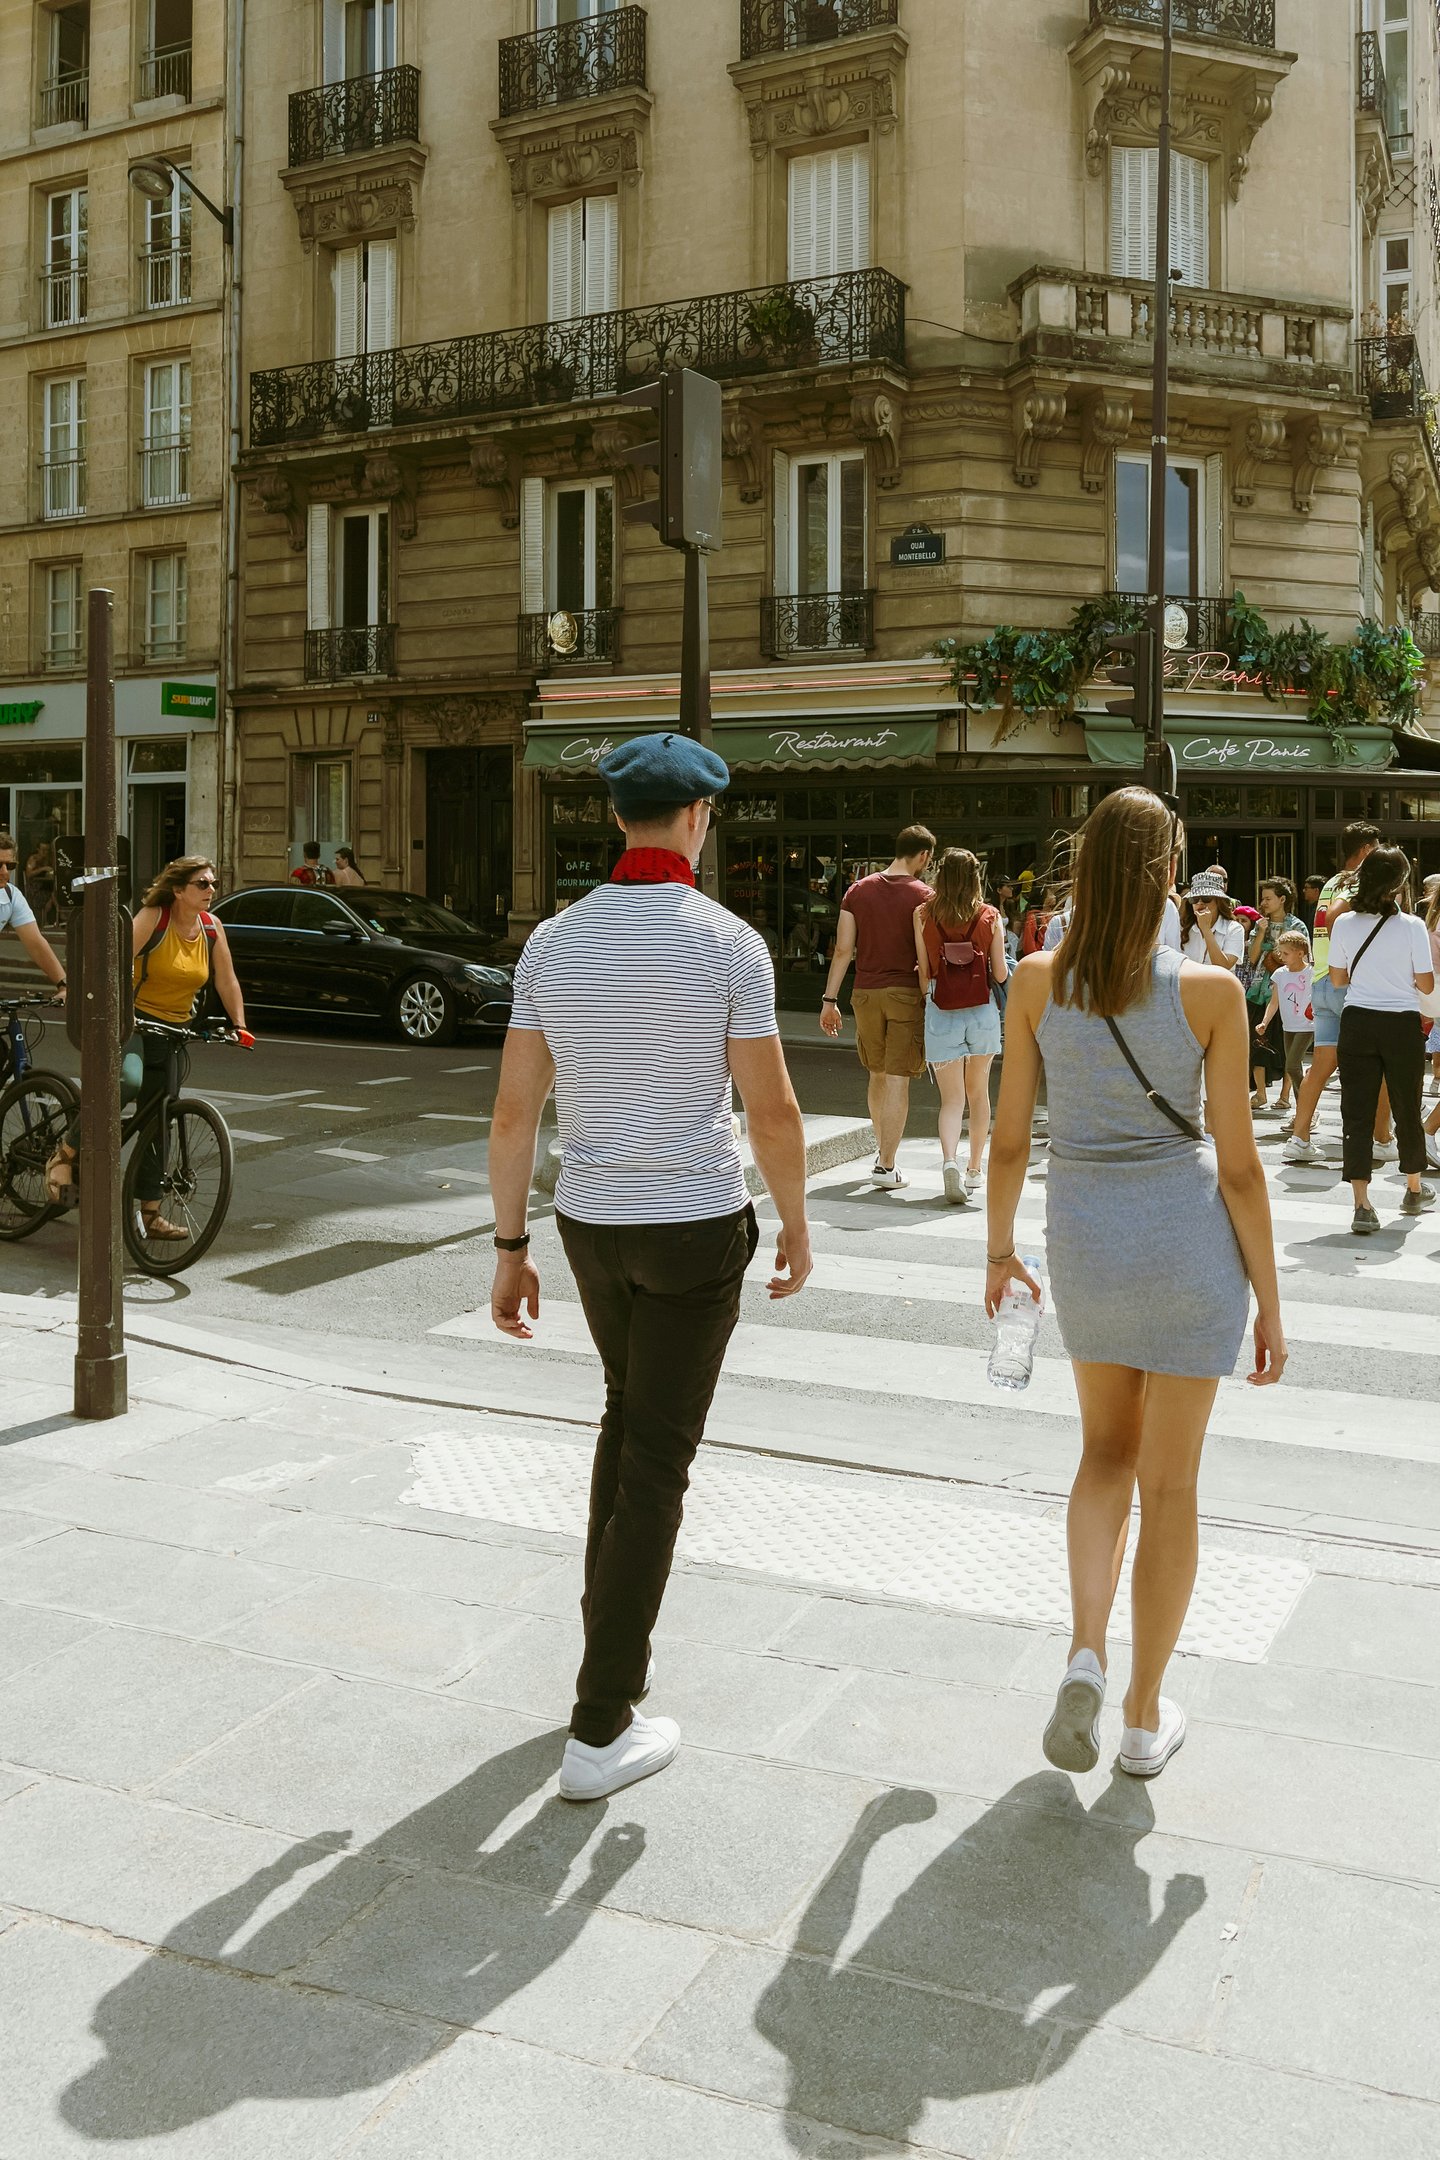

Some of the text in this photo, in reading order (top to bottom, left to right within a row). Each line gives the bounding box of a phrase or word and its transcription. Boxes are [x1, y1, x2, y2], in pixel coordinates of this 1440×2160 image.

[910, 541, 925, 550] QUAI
[898, 552, 937, 560] MONTEBELLO
[171, 694, 213, 706] SUBWAY
[768, 728, 898, 758] Restaurant
[560, 737, 614, 763] Café
[1182, 738, 1311, 763] Café Panis
[556, 878, 602, 887] GOURMAND
[734, 889, 763, 898] COUPE
